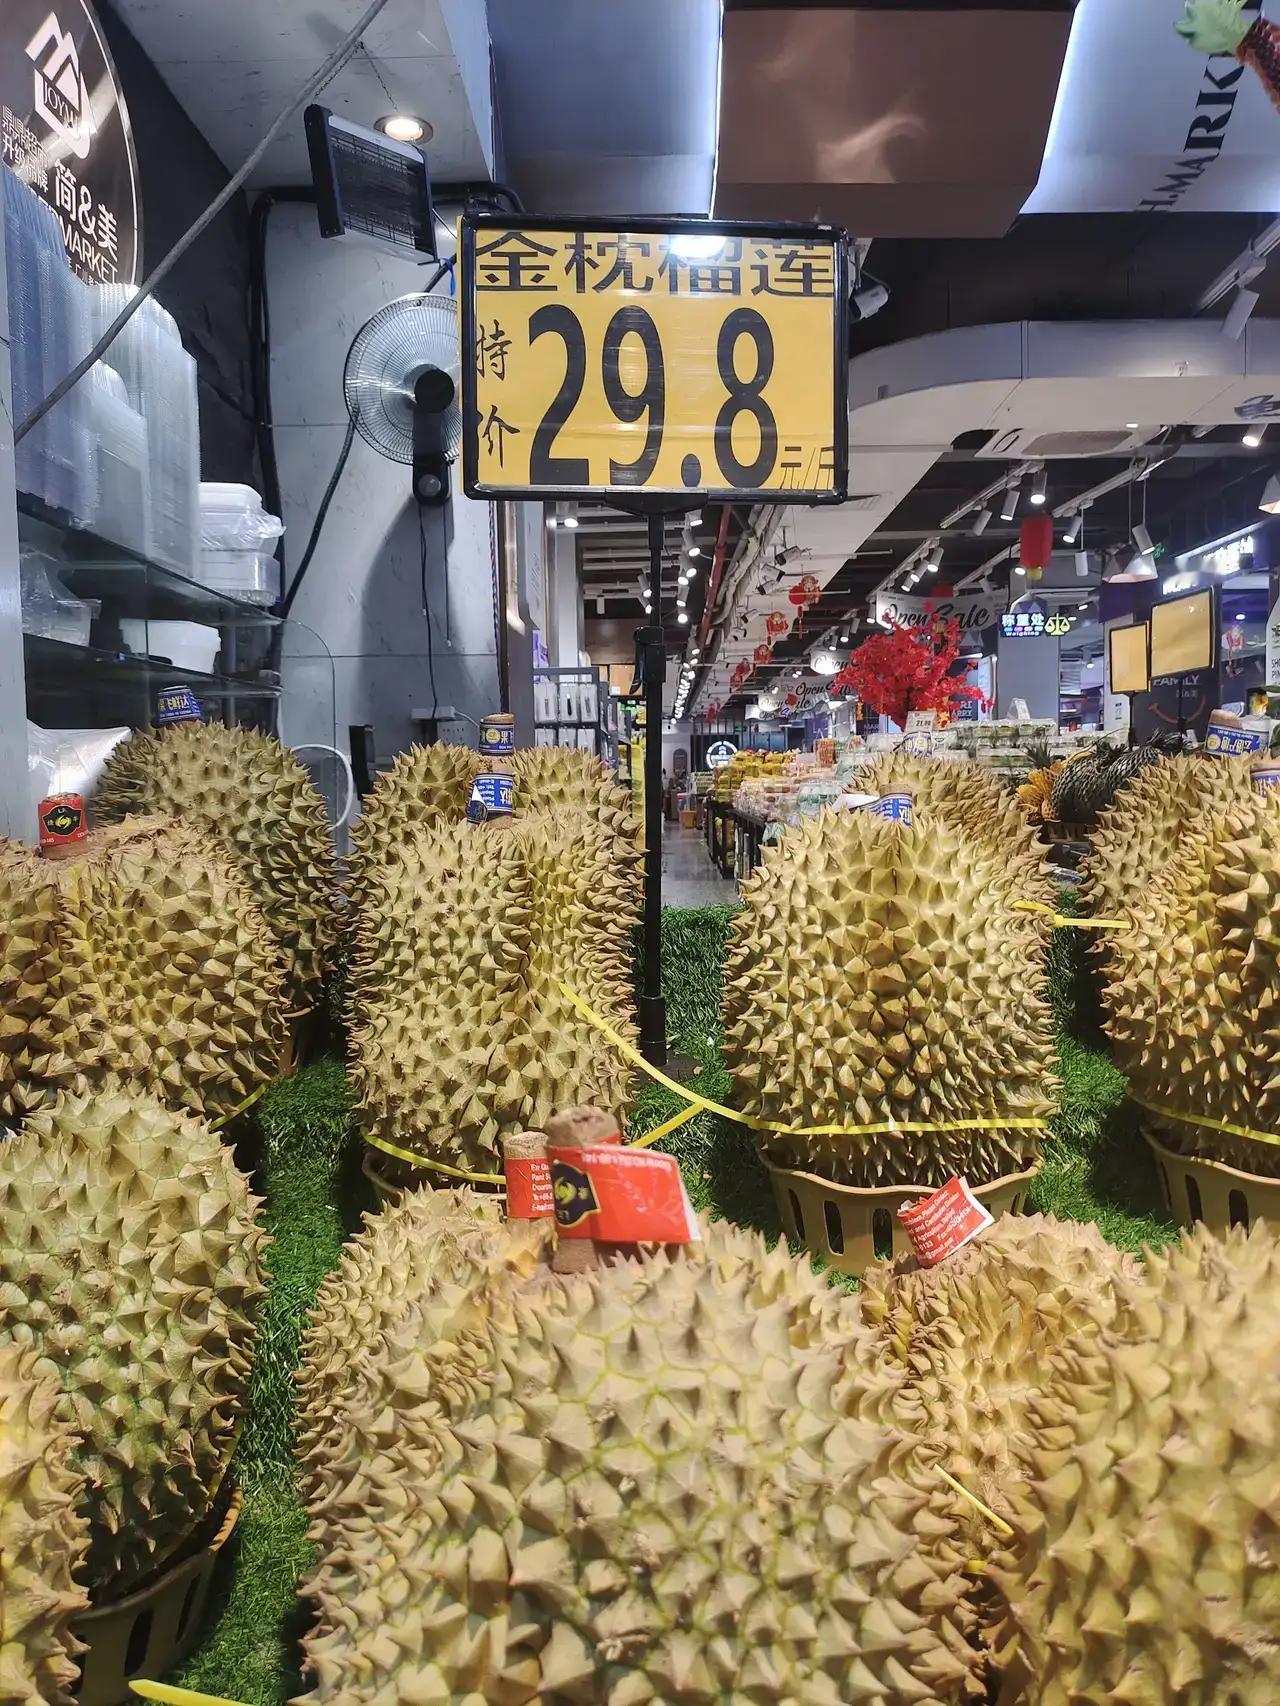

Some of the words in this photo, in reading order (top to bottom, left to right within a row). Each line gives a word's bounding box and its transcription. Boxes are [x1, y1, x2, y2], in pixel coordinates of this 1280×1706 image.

[55, 158, 118, 262] 简&美
[476, 231, 834, 298] 金枕榴莲
[528, 304, 778, 488] 29.8
[1002, 613, 1044, 626] 称重处
[795, 682, 824, 697] Open
